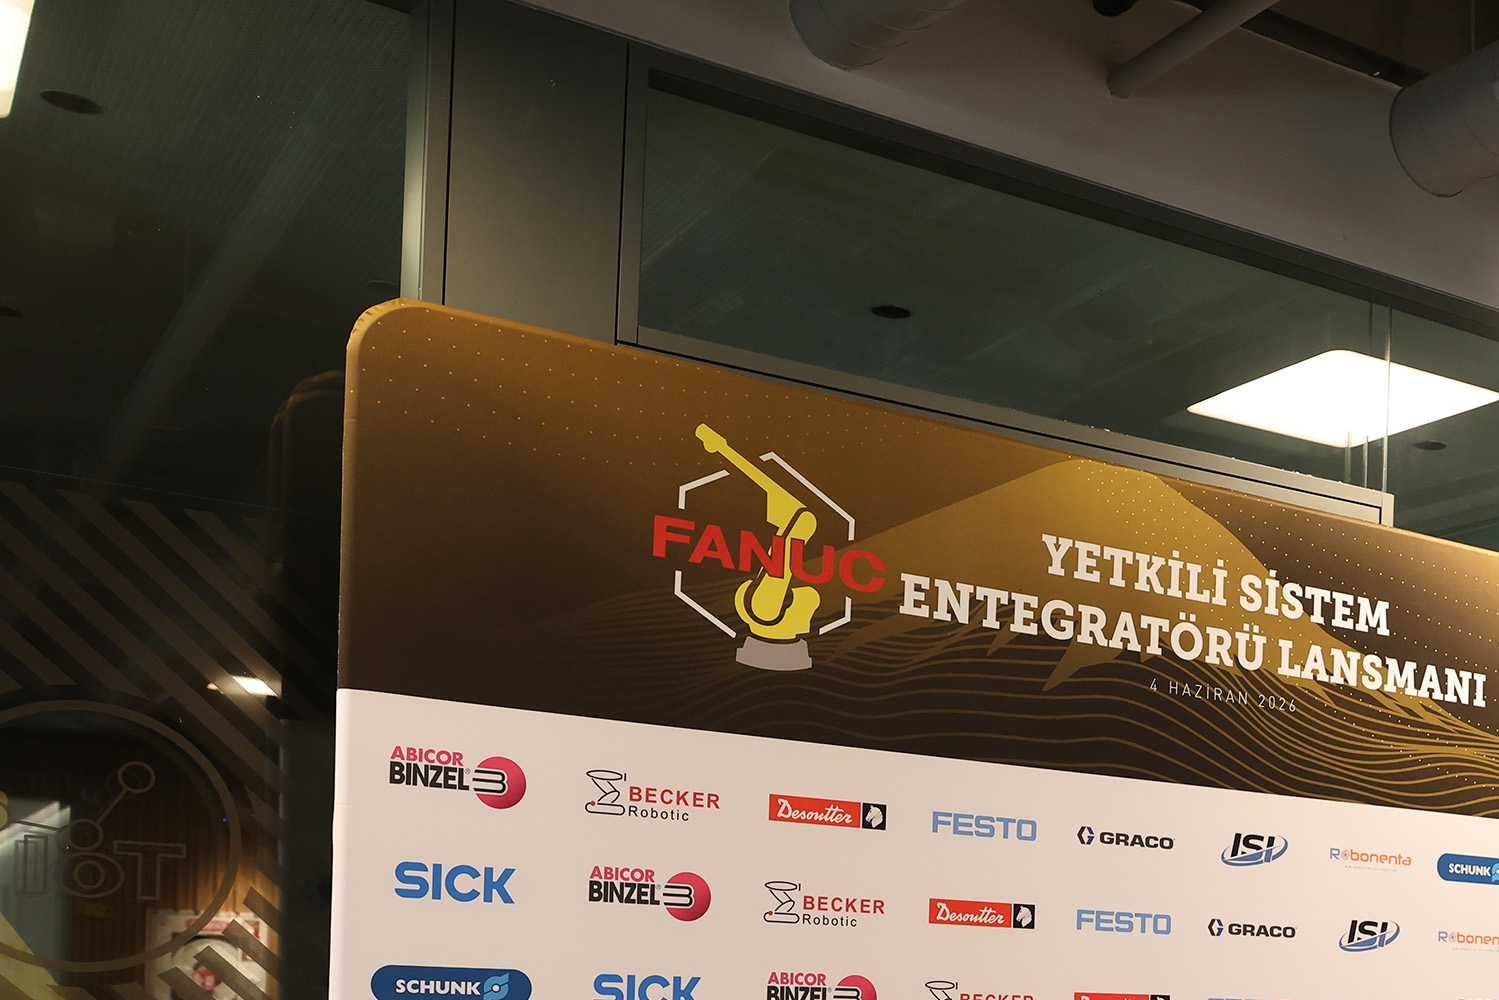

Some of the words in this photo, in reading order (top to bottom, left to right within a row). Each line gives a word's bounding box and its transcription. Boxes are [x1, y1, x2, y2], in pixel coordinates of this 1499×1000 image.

[652, 515, 886, 593] FANUC
[1042, 534, 1227, 607] YETKİLİ
[1240, 569, 1390, 636] SİSTEM
[899, 573, 1267, 671] ENTEGRATÖRÜ
[1278, 638, 1487, 708] LANSMANI
[1150, 678, 1157, 692] 4
[1168, 680, 1248, 705] HAZİRAN
[1258, 694, 1296, 712] 2026
[391, 746, 463, 766] ABICOR
[630, 786, 719, 808] BECKER
[629, 806, 690, 822] Robotic
[777, 799, 854, 825] Desoutter
[932, 811, 1036, 841] FESTO
[1100, 832, 1173, 849] GRACO
[1230, 833, 1275, 862] ISI
[590, 866, 654, 882] ABICOR
[1449, 863, 1491, 876] SCHUNK
[395, 861, 516, 904] SICK
[804, 896, 884, 914] BECKER
[937, 902, 1004, 923] Desoutter
[803, 914, 856, 927] Robotic
[1077, 910, 1171, 934] FESTO
[1229, 924, 1295, 938] GRACO
[1347, 920, 1388, 948] ISI
[396, 980, 480, 995] SCHUNK
[768, 972, 826, 985] ABICOR
